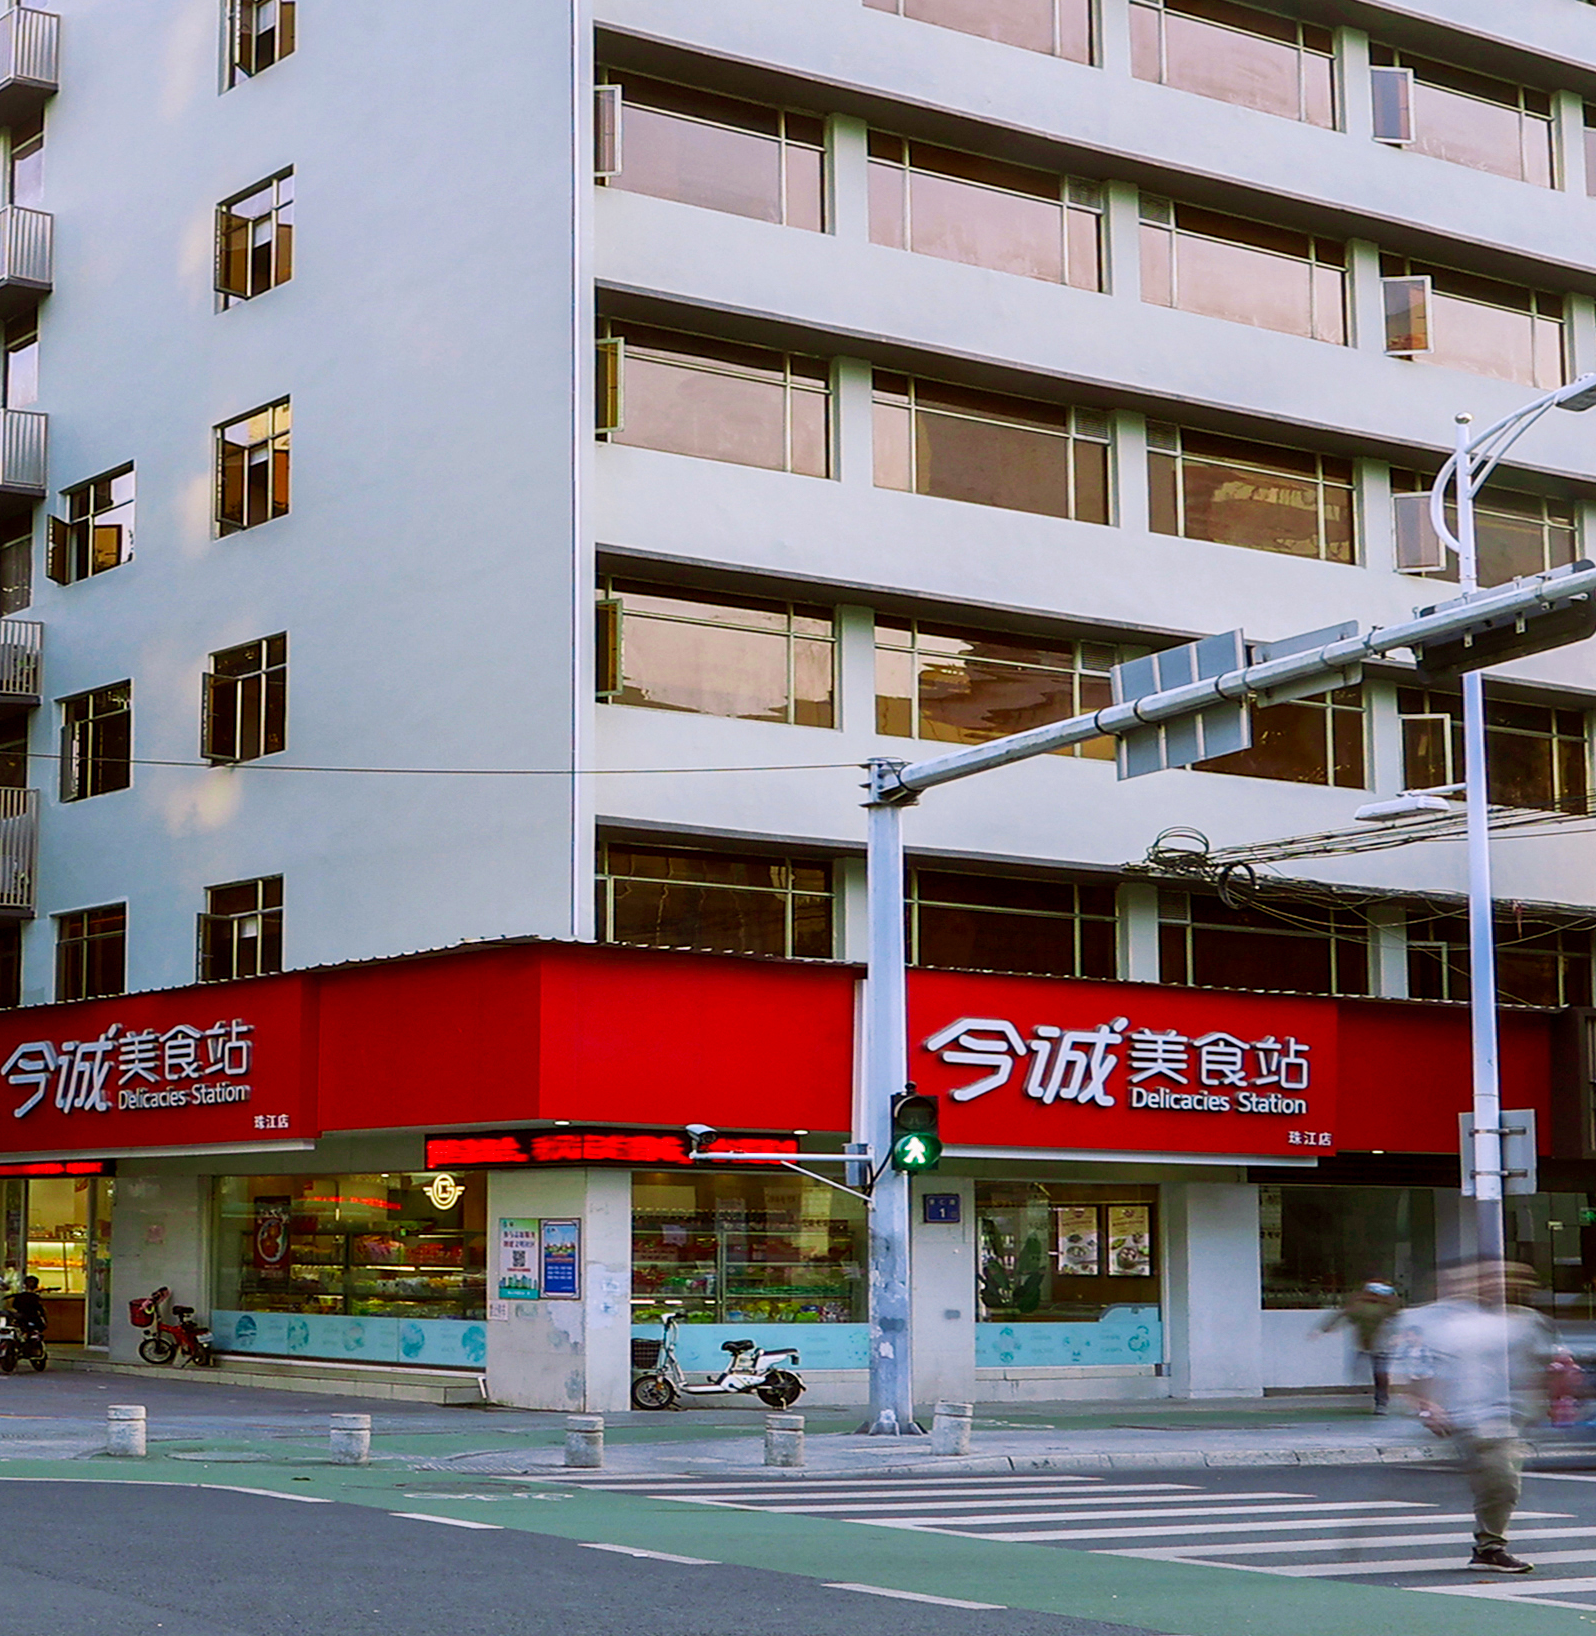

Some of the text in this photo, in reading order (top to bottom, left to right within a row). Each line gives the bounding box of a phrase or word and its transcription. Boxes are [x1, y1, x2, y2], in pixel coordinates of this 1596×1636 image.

[1, 1019, 254, 1118] 今诚美食站
[925, 1016, 1310, 1107] 今诚美食站
[118, 1083, 250, 1110] Delicacies Station
[1131, 1087, 1307, 1114] Delicacies Station
[253, 1113, 290, 1130] 珠江店
[1287, 1130, 1333, 1147] 珠江店
